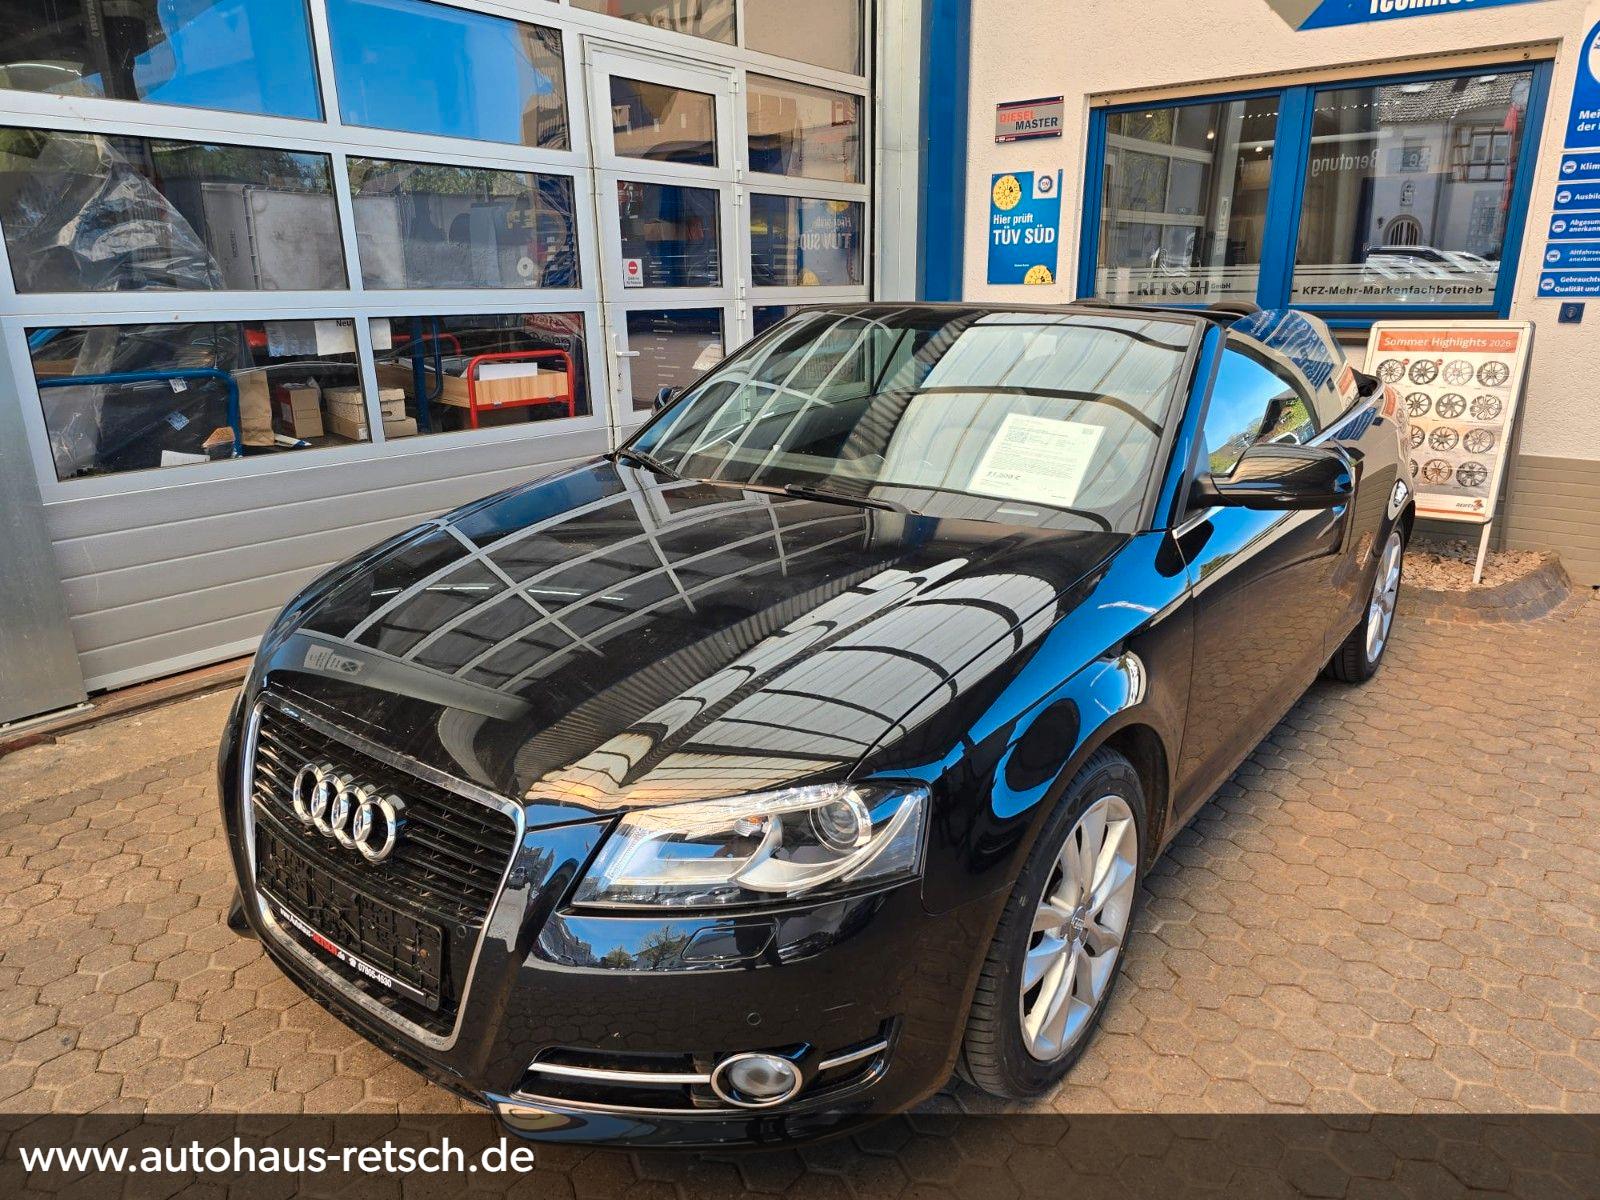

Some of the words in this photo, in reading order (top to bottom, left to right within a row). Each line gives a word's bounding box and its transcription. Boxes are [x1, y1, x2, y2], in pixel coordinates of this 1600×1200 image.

[999, 109, 1036, 123] DIESEL
[1016, 117, 1058, 130] MASTER
[1576, 121, 1597, 132] der
[993, 214, 1012, 225] Hier
[1013, 213, 1034, 227] prüft
[993, 225, 1021, 246] TÜV
[1024, 223, 1056, 244] SÜD
[1136, 280, 1210, 297] RETSCH
[1210, 282, 1232, 290] GmbH
[1302, 285, 1484, 296] KFZ-Mehr-Markenfachbetrieb
[1384, 337, 1429, 347] Sommer
[1431, 337, 1487, 349] Highlights
[1489, 339, 1512, 348] 2026
